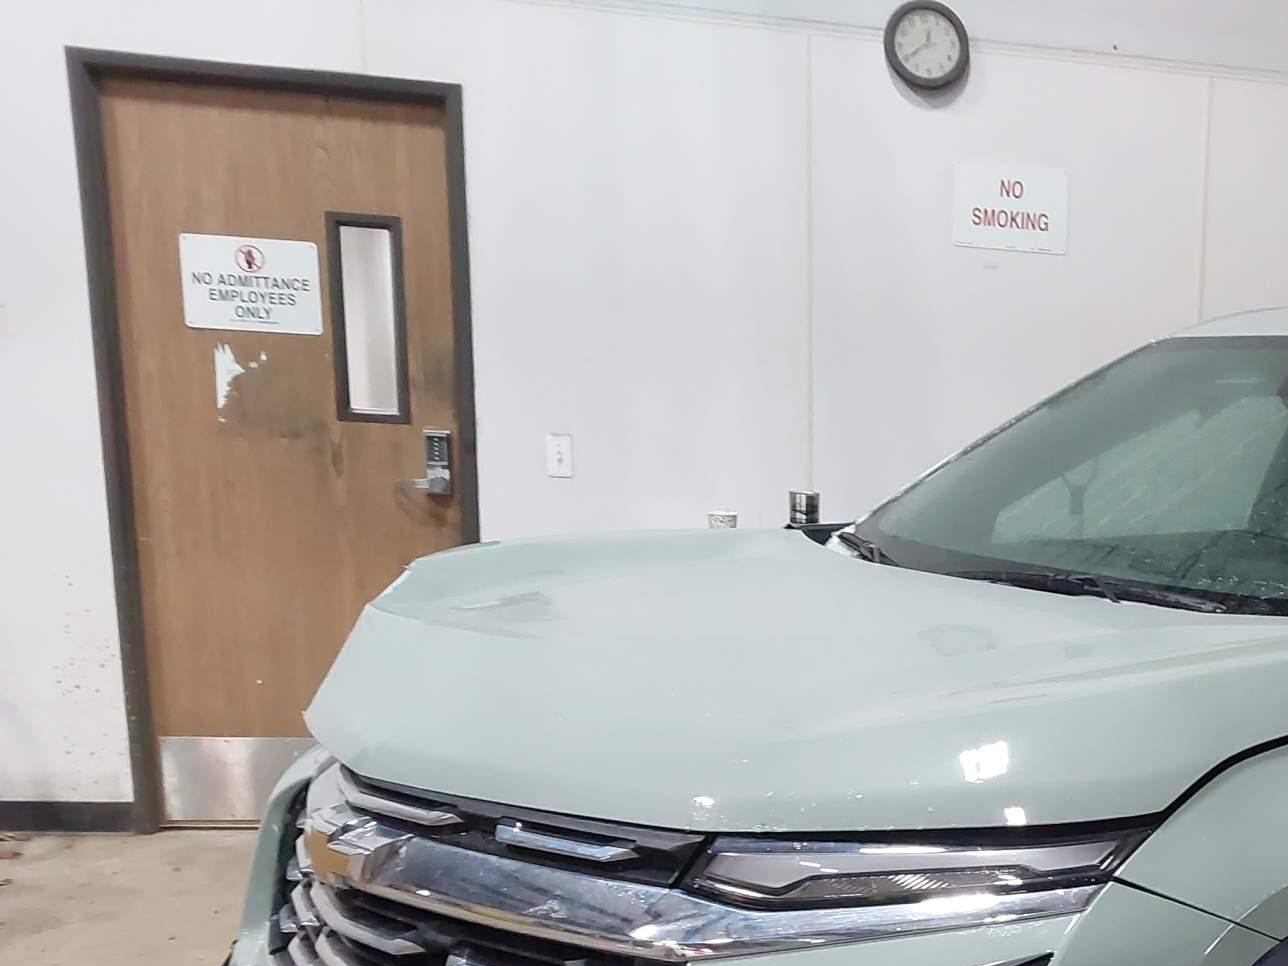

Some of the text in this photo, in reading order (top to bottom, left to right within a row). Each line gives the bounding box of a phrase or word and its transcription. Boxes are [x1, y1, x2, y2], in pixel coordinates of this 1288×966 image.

[1000, 179, 1024, 199] NO
[971, 207, 1049, 232] SMOKING
[191, 272, 311, 292] NO ADMITTANCE
[208, 288, 297, 306] EMPLOYEES
[234, 305, 272, 319] ONLY
